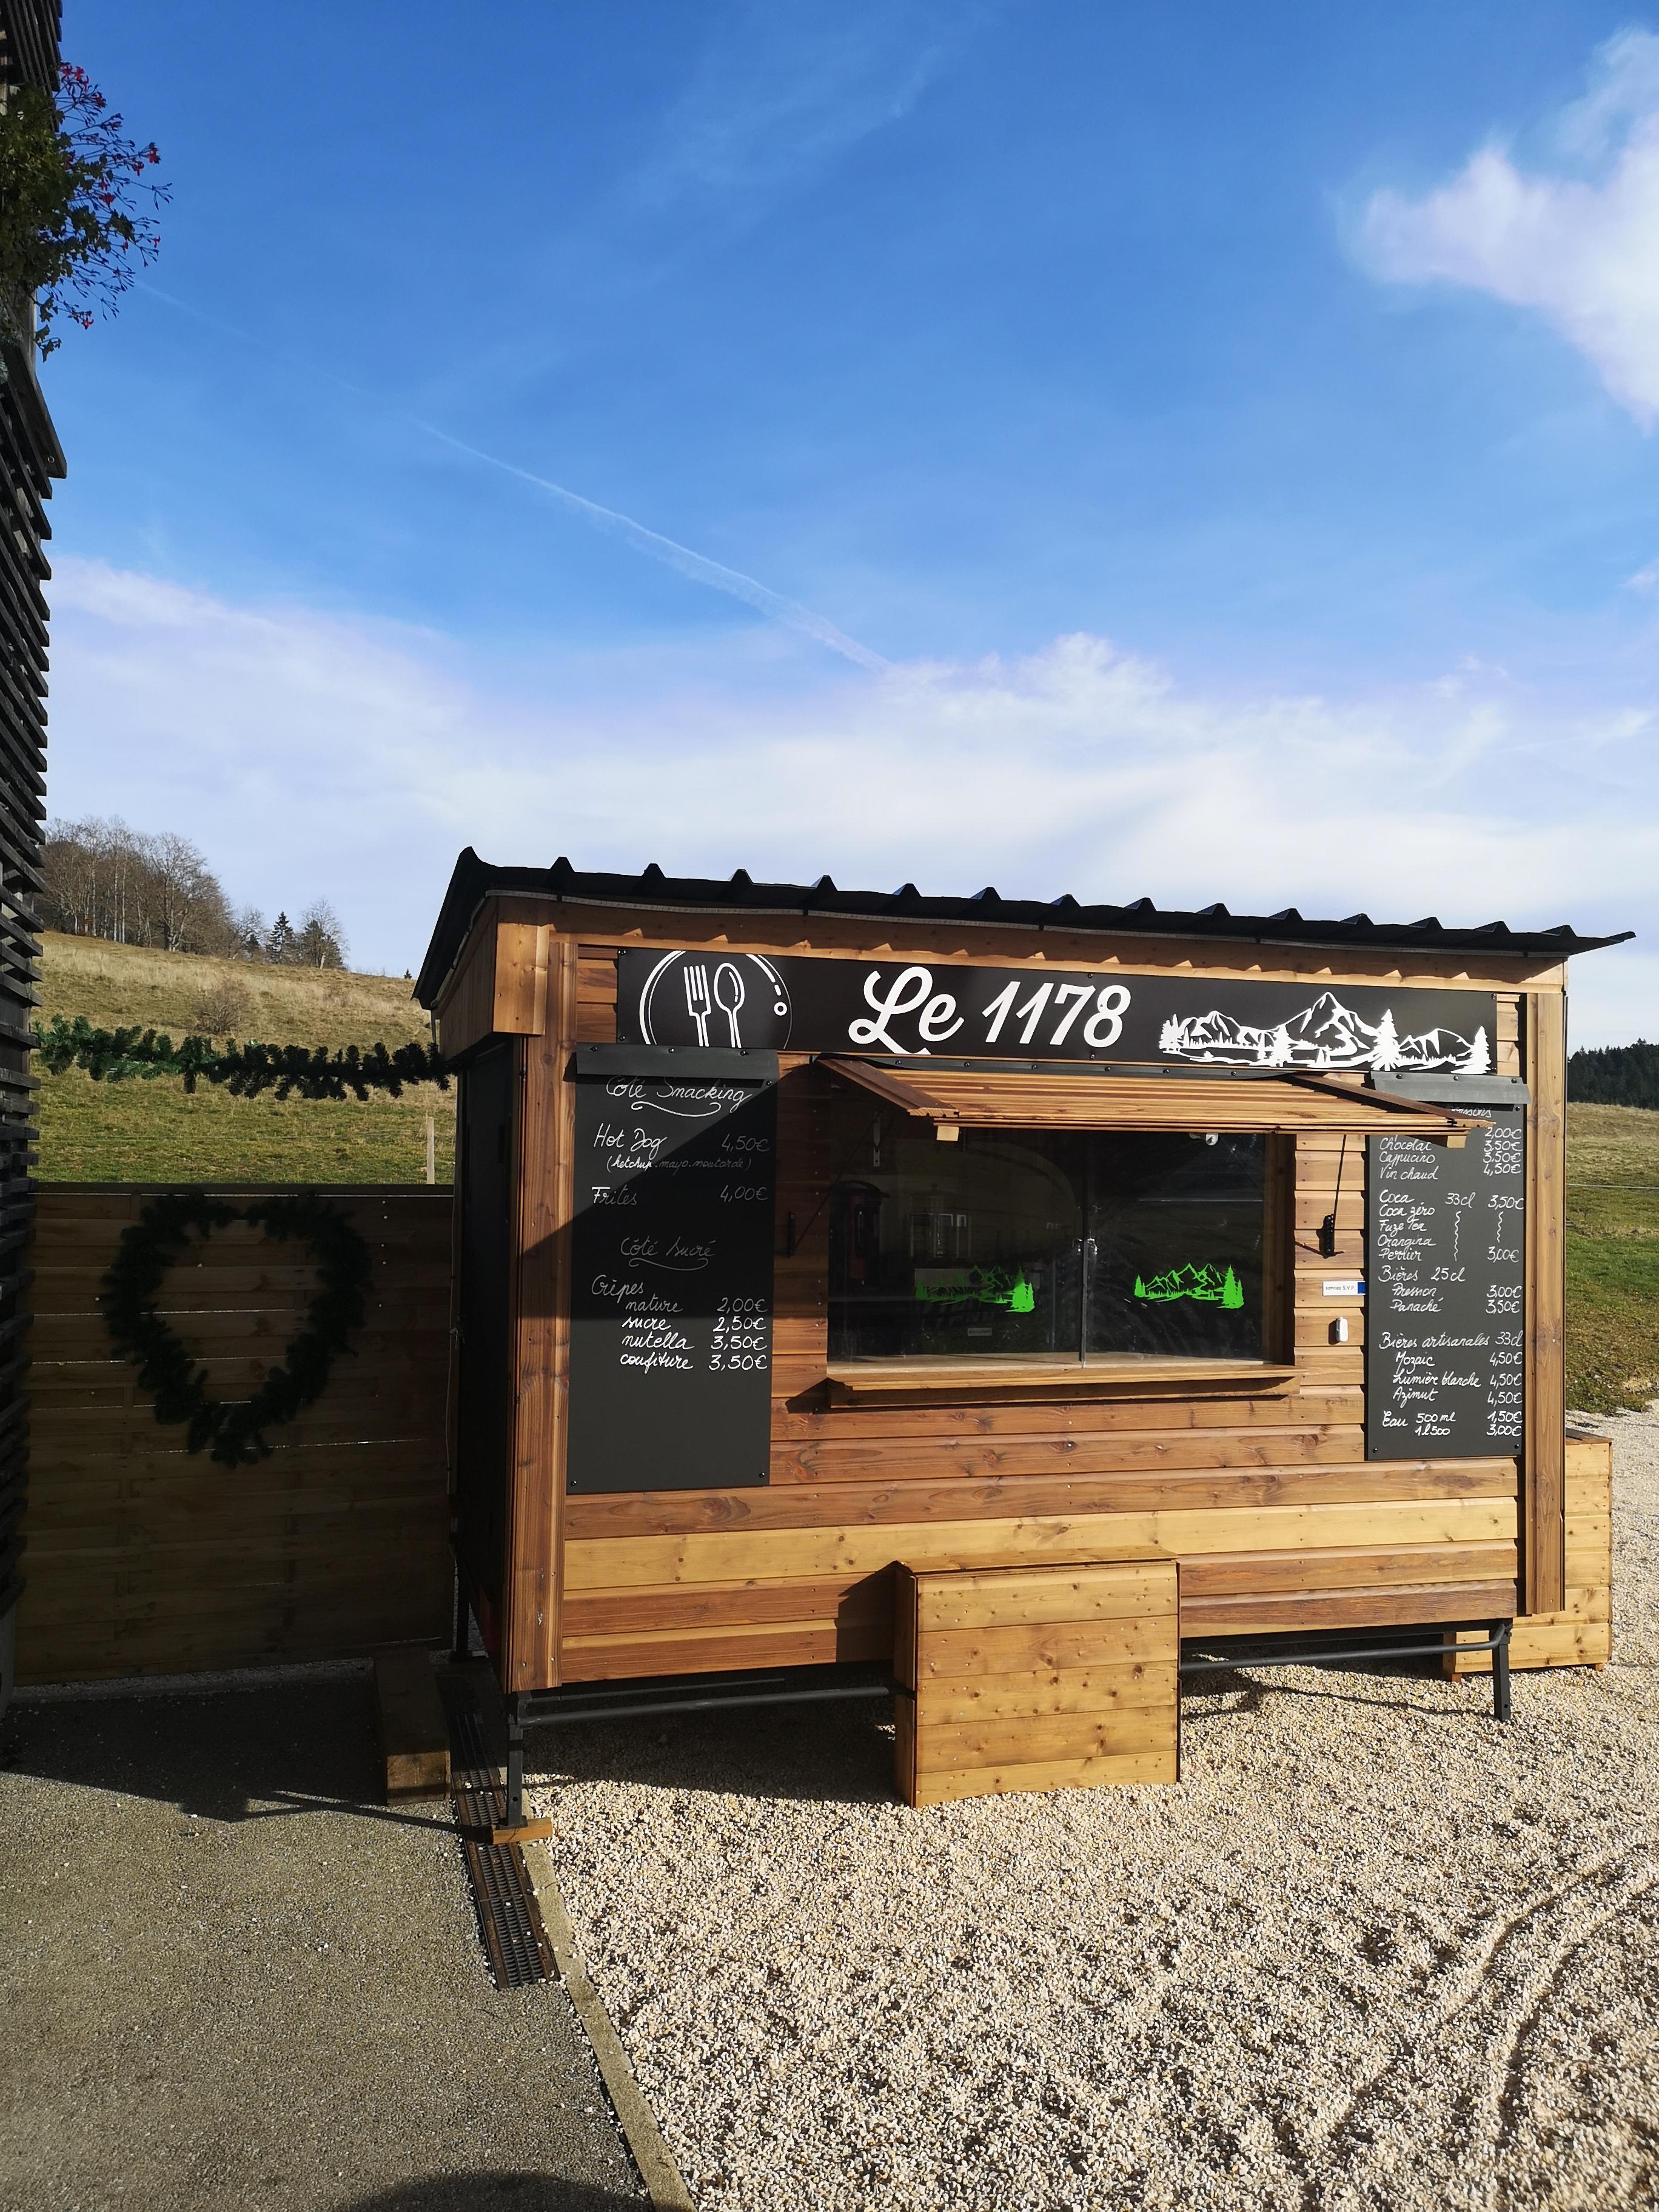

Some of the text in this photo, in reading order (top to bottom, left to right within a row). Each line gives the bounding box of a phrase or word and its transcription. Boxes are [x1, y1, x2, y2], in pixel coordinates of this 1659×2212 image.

[848, 966, 1131, 1056] Le 1178
[593, 1122, 770, 1159] Hot Dog 4,50€
[1484, 1127, 1522, 1139] 2,00€
[1379, 1134, 1523, 1152] Chocolat 3,50€
[1483, 1151, 1521, 1164] 3,50€
[1379, 1163, 1522, 1180] Vin chaud 4,50€
[592, 1184, 768, 1205] Frites 4,00€
[1379, 1188, 1415, 1204] Coca
[1487, 1195, 1524, 1210] 3,50€
[1379, 1204, 1407, 1217] Coca
[1379, 1218, 1427, 1238] Fuze Tea
[1377, 1234, 1437, 1252] Orangina
[1378, 1246, 1520, 1263] Perrier 3,00€
[1378, 1264, 1418, 1282] Bières
[591, 1274, 644, 1304] Crêpes
[1392, 1282, 1523, 1298] Pression 3,00€
[625, 1293, 768, 1315] nature 2,00€
[1389, 1297, 1520, 1314] Panaché 3,50€
[621, 1316, 767, 1334] sucre 2,50€
[621, 1330, 768, 1351] nutella 3,50€
[1379, 1332, 1418, 1350] Bières
[1421, 1331, 1490, 1348] artisanales
[620, 1351, 768, 1375] confiture 3,50€
[1489, 1352, 1523, 1367] 4,50€
[1392, 1368, 1523, 1390] Lumière blanche 4,50€
[1392, 1386, 1523, 1409] Azimut 4,50€
[1382, 1410, 1409, 1427] Eau
[1487, 1410, 1523, 1424] 1,50€
[1486, 1424, 1522, 1437] 3,00€
